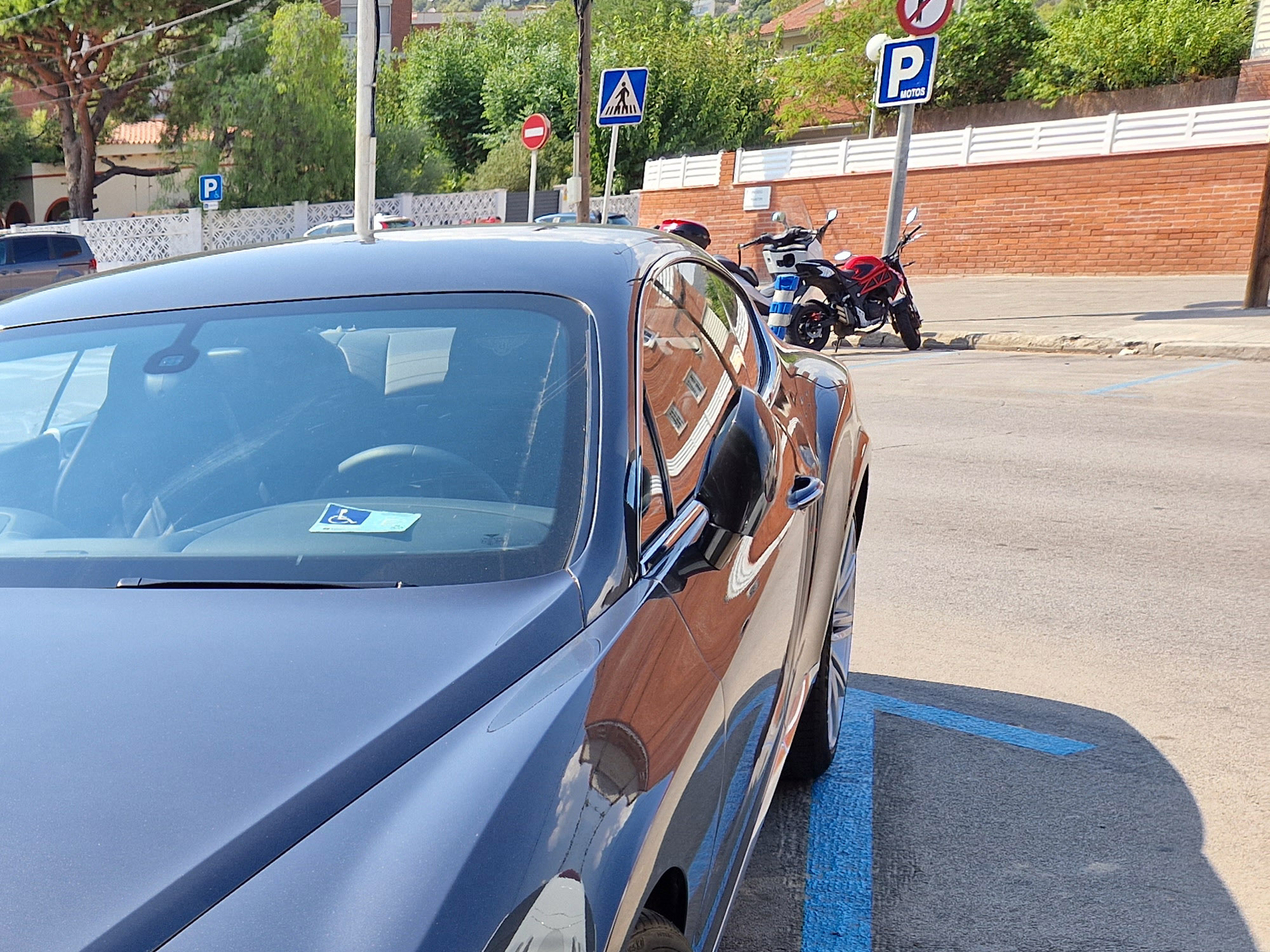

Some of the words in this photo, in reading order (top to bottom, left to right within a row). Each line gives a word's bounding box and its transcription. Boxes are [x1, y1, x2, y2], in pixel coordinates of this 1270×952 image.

[887, 45, 925, 99] P
[900, 87, 926, 99] MOTOS
[204, 178, 218, 199] P
